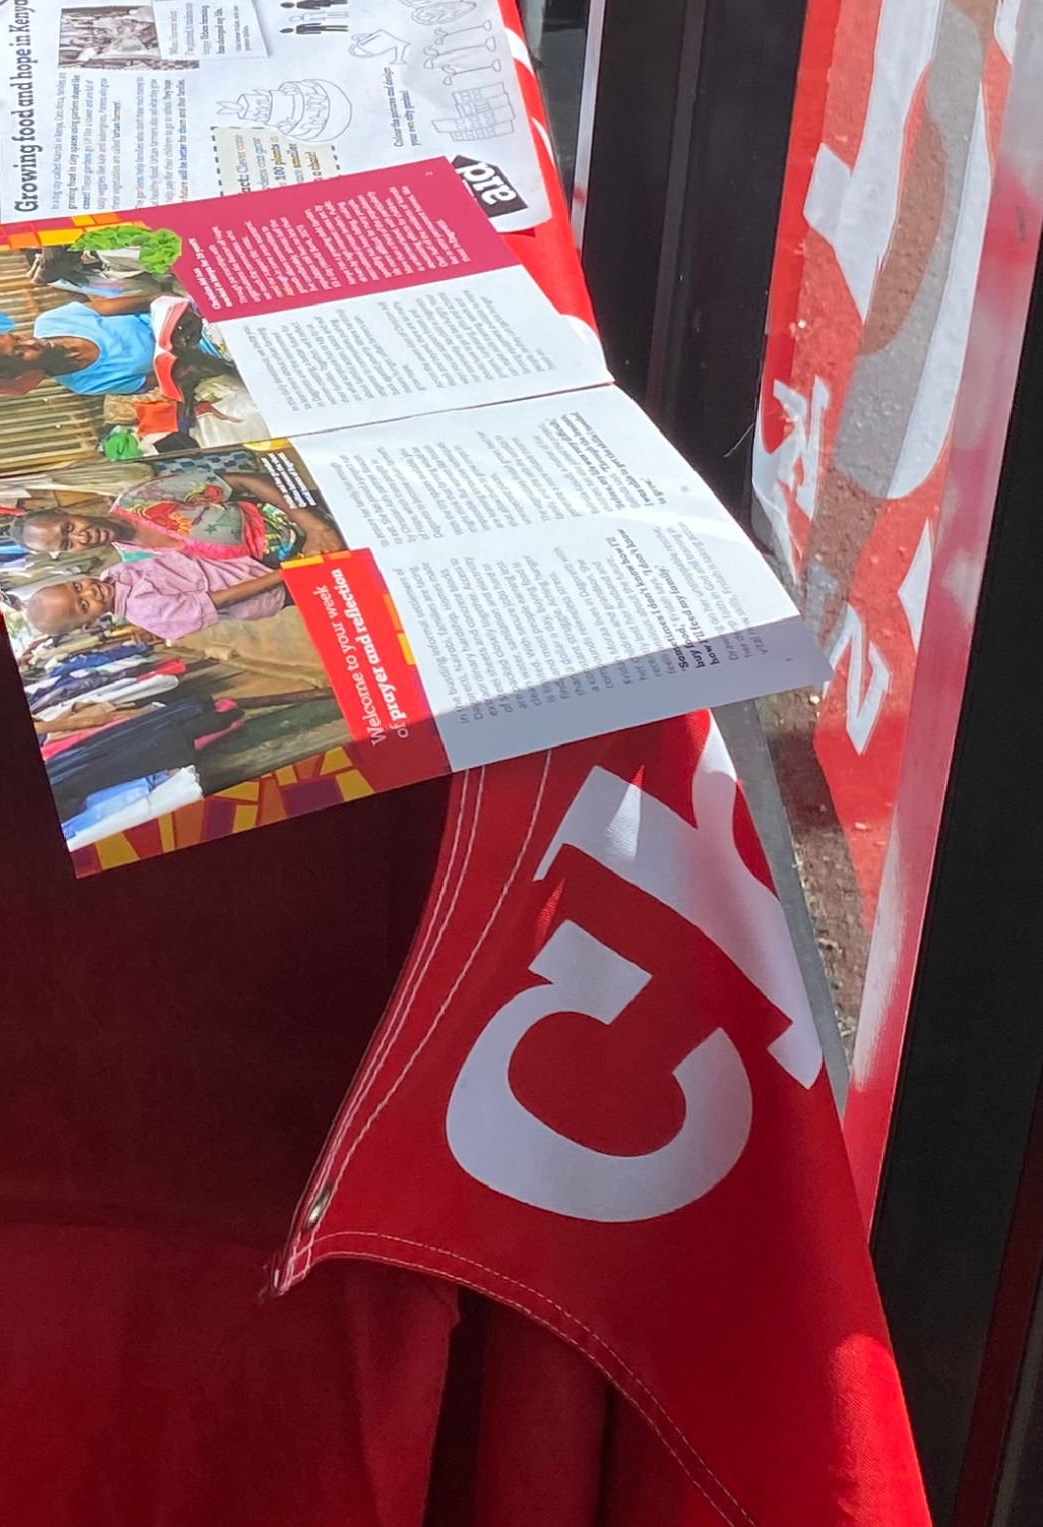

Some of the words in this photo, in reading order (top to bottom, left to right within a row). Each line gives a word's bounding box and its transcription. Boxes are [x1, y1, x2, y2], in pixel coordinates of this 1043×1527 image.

[11, 34, 30, 46] in
[215, 25, 225, 44] changed
[10, 48, 38, 79] hope
[9, 81, 33, 105] and
[384, 86, 394, 96] and
[389, 97, 400, 117] pictures
[403, 110, 414, 120] city
[10, 108, 35, 141] food
[390, 119, 399, 127] the
[234, 134, 244, 150] cone
[252, 137, 266, 153] grow
[392, 128, 403, 146] Colour
[410, 133, 421, 146] your
[235, 151, 247, 172] Clever
[256, 155, 265, 167] can
[271, 143, 285, 164] plants
[286, 143, 301, 167] smaller
[304, 151, 320, 169] chair!
[13, 143, 42, 212] Growing
[237, 174, 250, 192] act:
[273, 166, 286, 180] 100
[455, 161, 516, 204] aid
[617, 528, 634, 548] know
[450, 557, 459, 565] to
[614, 547, 630, 565] how
[392, 567, 404, 575] of
[409, 565, 424, 588] facing
[421, 561, 437, 582] made
[440, 568, 457, 590] blocks
[454, 566, 472, 591] Access
[463, 555, 486, 591] electricity
[625, 564, 642, 587] know
[311, 584, 339, 619] week
[329, 567, 366, 633] reflection
[397, 576, 423, 618] settlement
[419, 589, 430, 601] are
[431, 583, 449, 610] Homes
[478, 591, 494, 607] and
[636, 587, 656, 610] don't
[674, 594, 688, 609] my
[425, 602, 446, 636] families
[451, 590, 475, 628] concrete
[655, 595, 678, 622] Fridah
[489, 608, 515, 651] sanitation
[680, 609, 700, 630] feed
[330, 620, 358, 653] your
[415, 619, 440, 656] informal
[467, 628, 483, 646] and
[484, 627, 504, 657] closely
[353, 633, 380, 665] and
[439, 636, 462, 672] Nairobi,
[690, 649, 706, 668] buy
[703, 643, 720, 664] how
[344, 654, 360, 671] to
[478, 647, 497, 676] sheets
[434, 655, 457, 695] bustling
[463, 651, 499, 716] extraordinary
[497, 658, 524, 692] packed
[370, 665, 408, 721] prayer
[489, 677, 509, 701] steel
[524, 680, 542, 706] clean
[351, 671, 389, 745] Welcome
[452, 695, 465, 712] the
[501, 702, 514, 712] of
[515, 691, 529, 709] are
[459, 712, 470, 724] In
[389, 720, 411, 738] of
